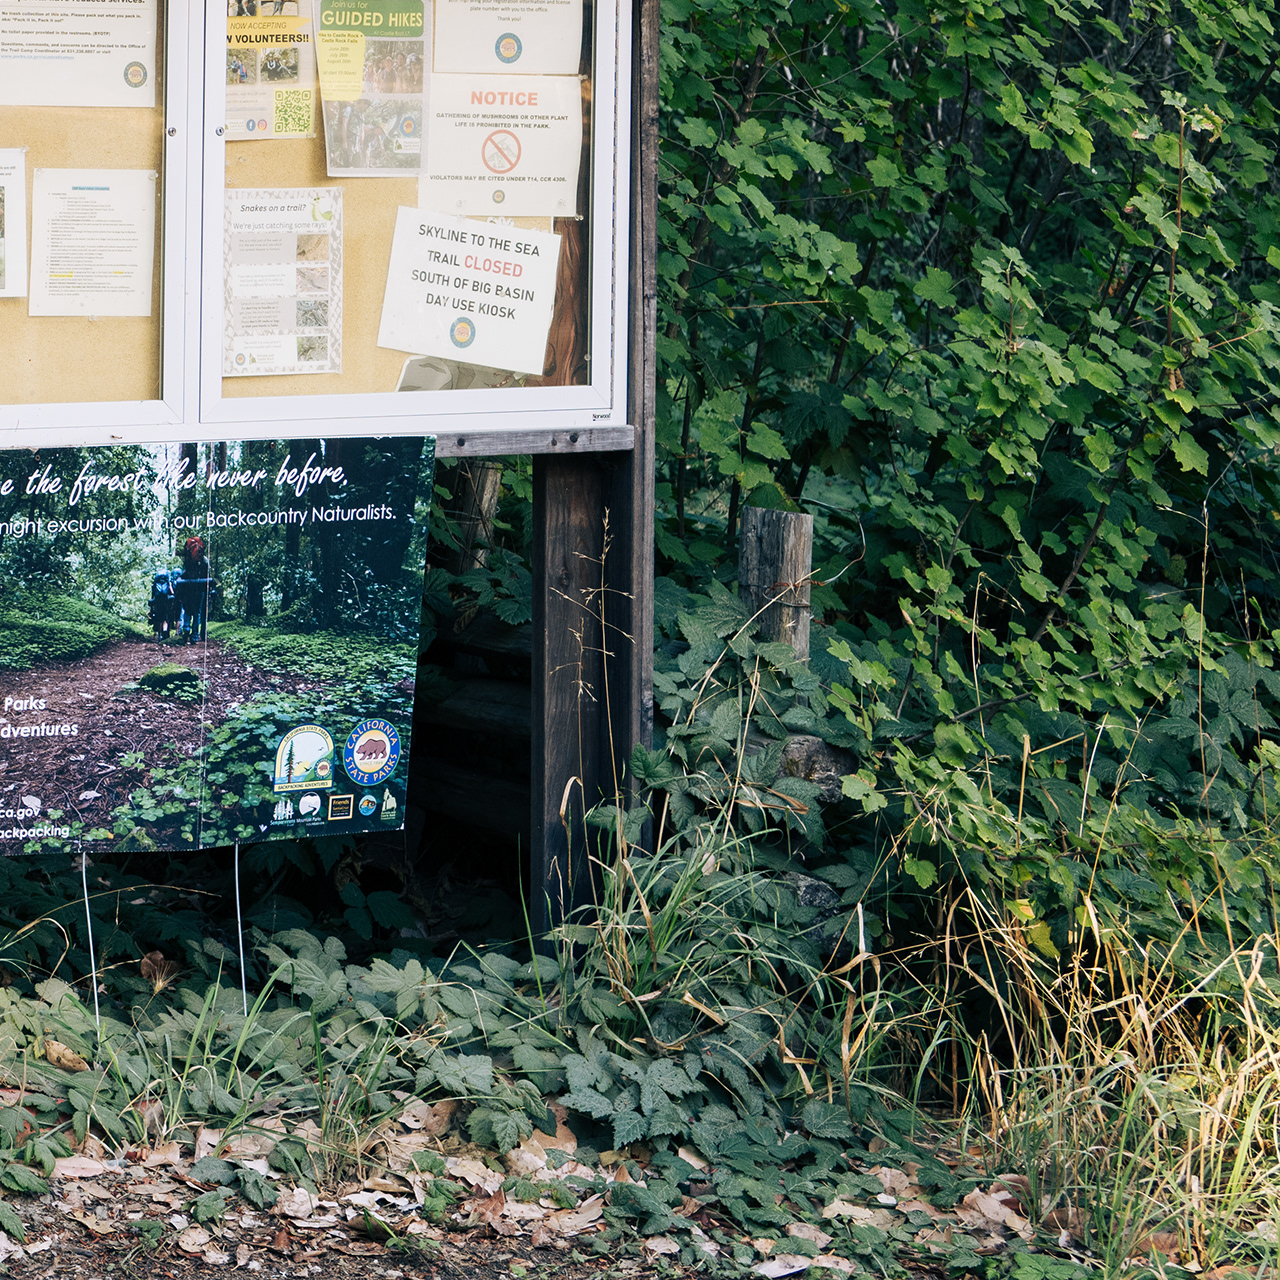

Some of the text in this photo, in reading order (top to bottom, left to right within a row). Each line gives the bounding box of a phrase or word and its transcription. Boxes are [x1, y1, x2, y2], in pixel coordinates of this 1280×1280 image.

[322, 10, 423, 27] GUIDED HIKES
[357, 1, 368, 9] for
[230, 21, 287, 30] NOW ACCEPTING
[235, 33, 309, 44] VOLUNTEERS!!
[470, 91, 539, 107] NOTICE
[240, 204, 267, 213] Snakes
[286, 203, 307, 212] trail?
[418, 224, 540, 257] SKYLINE TO THE SEA
[427, 249, 523, 278] TRAIL CLOSED
[411, 269, 535, 302] SOUTH OF BIG BASIN
[426, 292, 516, 320] DAY USE KIOSK
[26, 464, 63, 495] the
[68, 461, 148, 507] forest
[154, 457, 197, 490] like
[206, 467, 268, 491] never
[274, 452, 349, 498] before.
[47, 515, 129, 534] excursion
[132, 510, 170, 529] with
[174, 515, 203, 529] our
[206, 508, 308, 530] Backcountry
[312, 504, 397, 523] Naturalists.
[4, 696, 47, 712] Parks
[346, 719, 399, 750] CALIFORNIA
[345, 753, 399, 783] STATE PARKS
